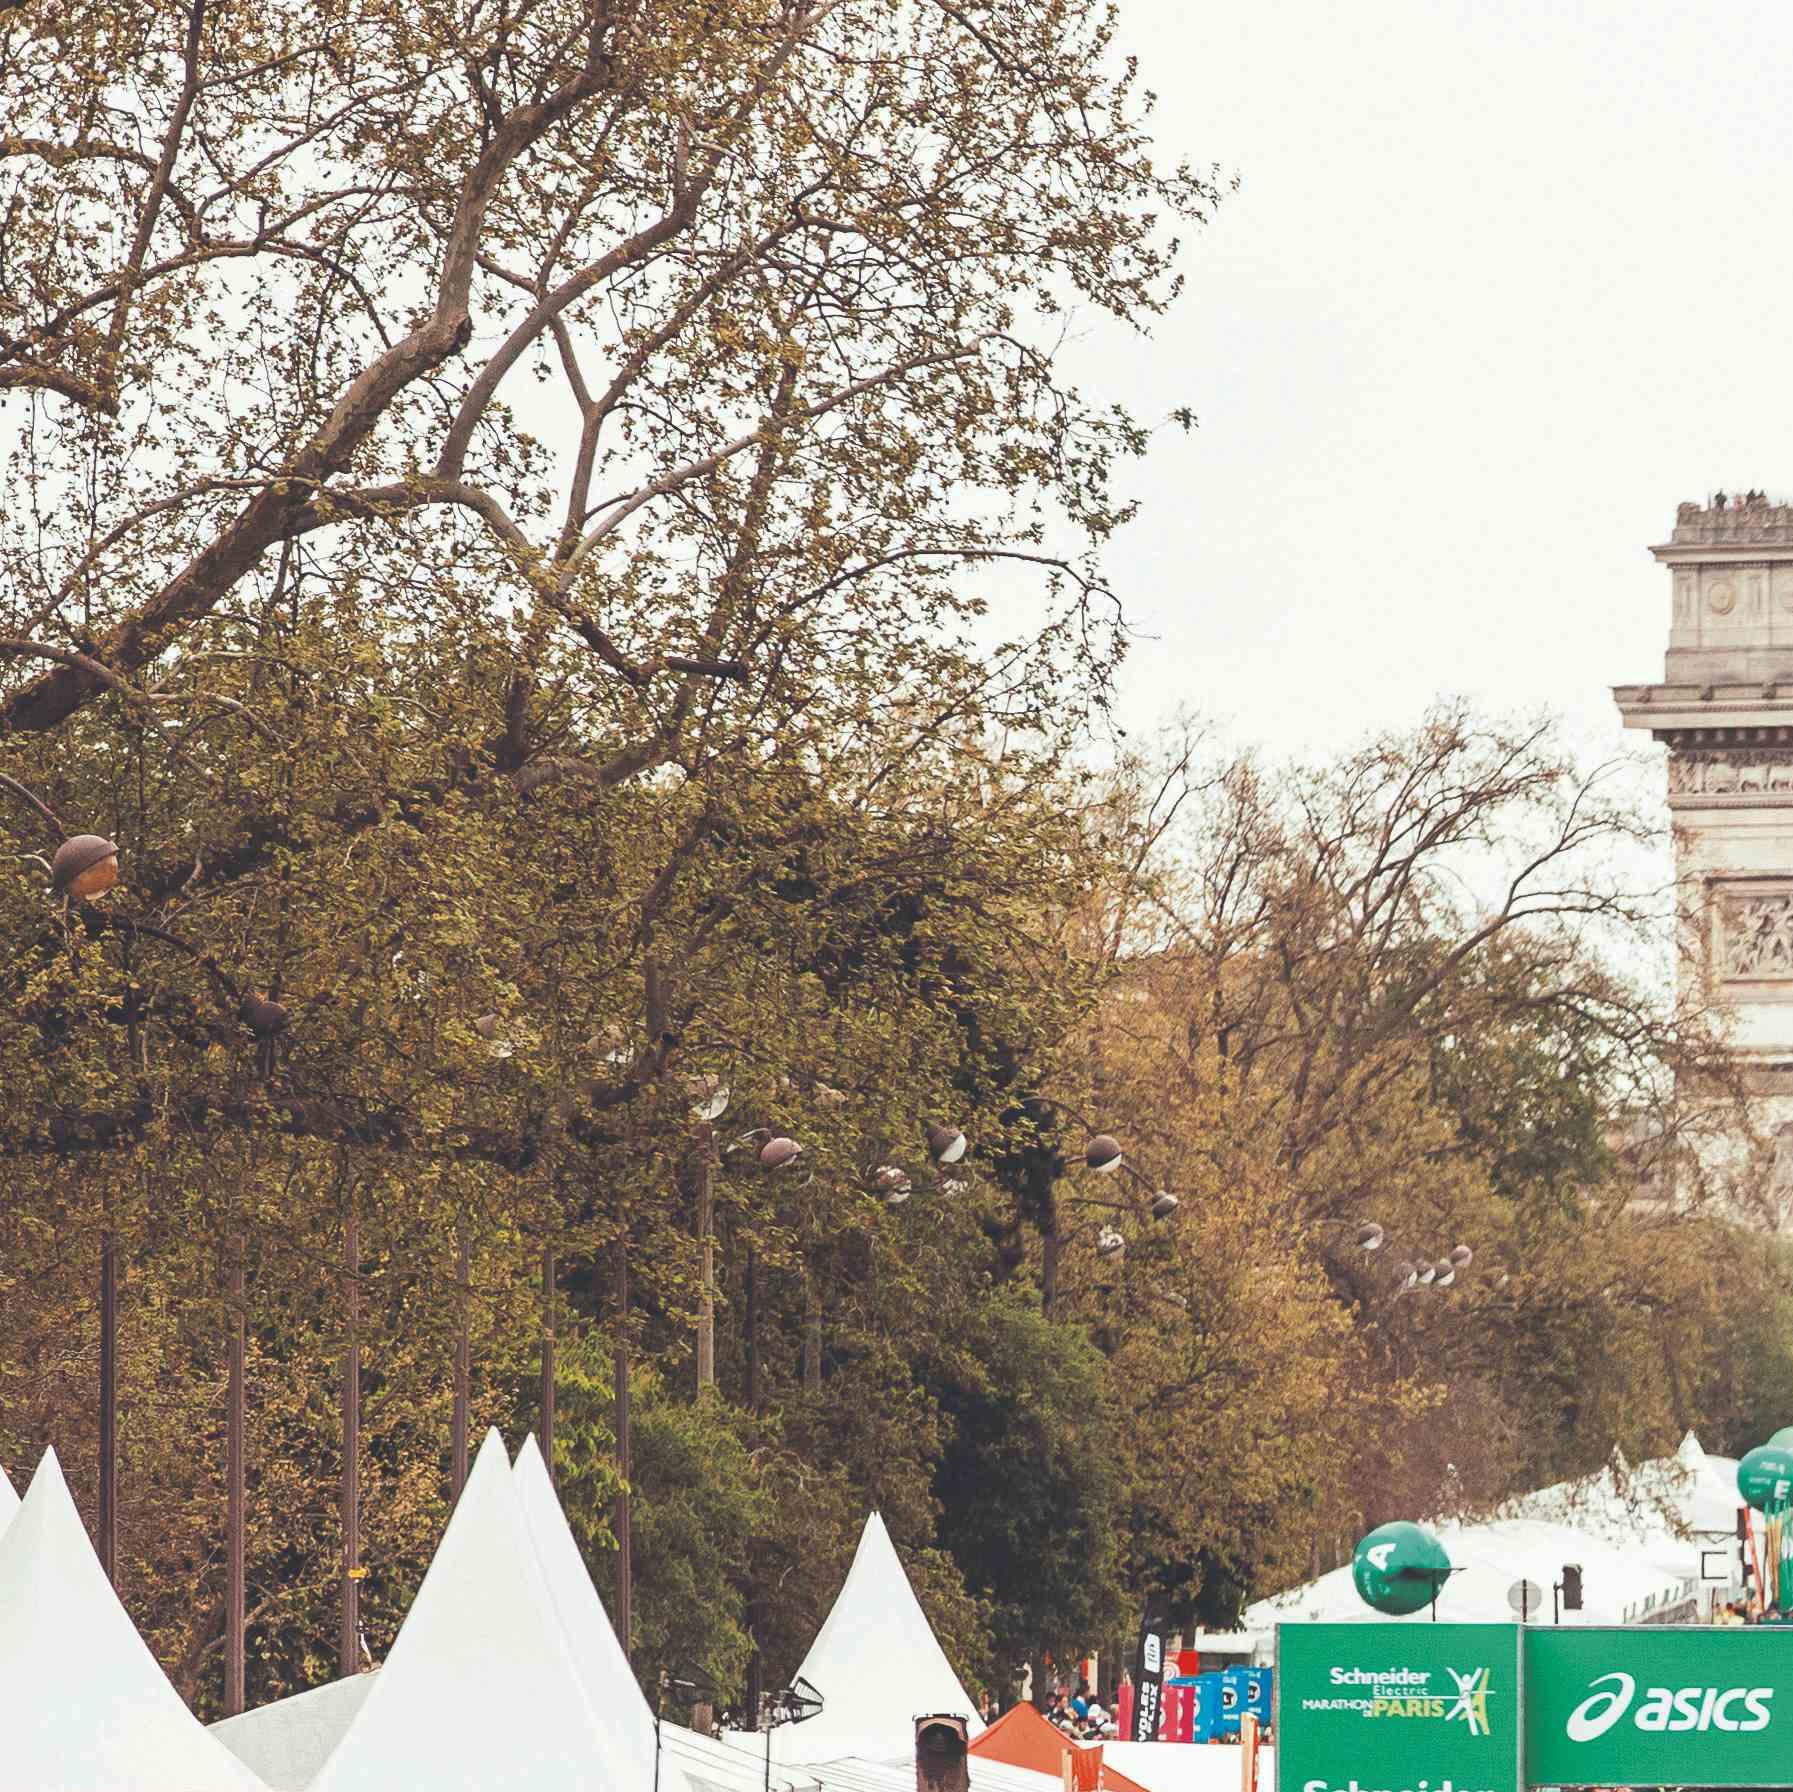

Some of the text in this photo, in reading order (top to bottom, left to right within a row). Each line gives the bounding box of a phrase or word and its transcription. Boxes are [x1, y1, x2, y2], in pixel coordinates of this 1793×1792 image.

[1774, 1480, 1791, 1499] E
[1366, 1543, 1397, 1571] A
[1330, 1667, 1430, 1684] Schneider
[1373, 1685, 1428, 1696] Electric
[1302, 1699, 1445, 1717] MARATHON PARIS
